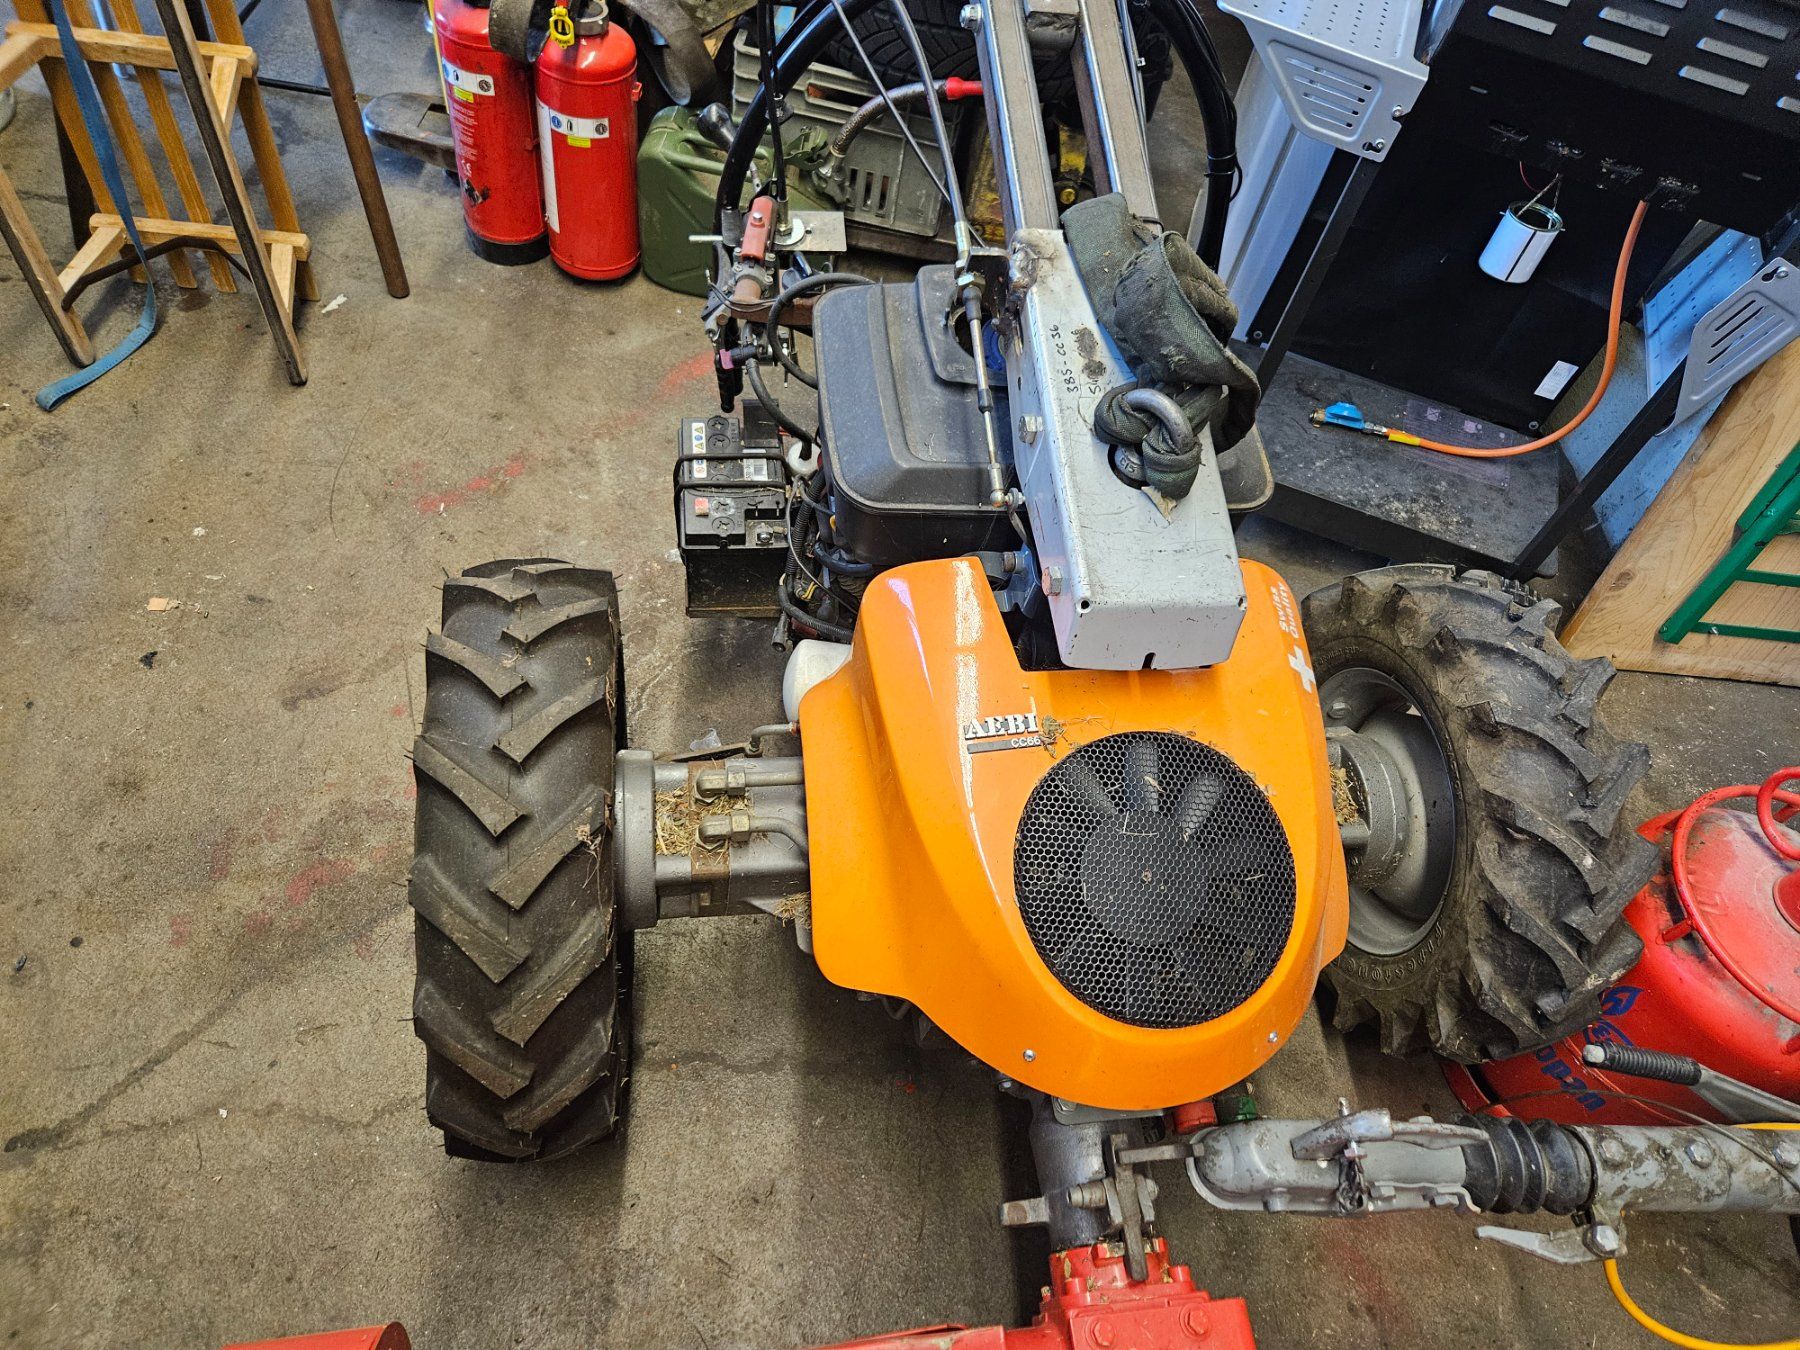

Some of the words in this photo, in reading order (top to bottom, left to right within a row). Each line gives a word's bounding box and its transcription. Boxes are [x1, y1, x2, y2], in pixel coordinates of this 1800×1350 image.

[1270, 585, 1289, 633] Swiss
[1278, 581, 1299, 639] Quality
[964, 712, 1040, 741] AEBI
[1010, 735, 1041, 748] CC66
